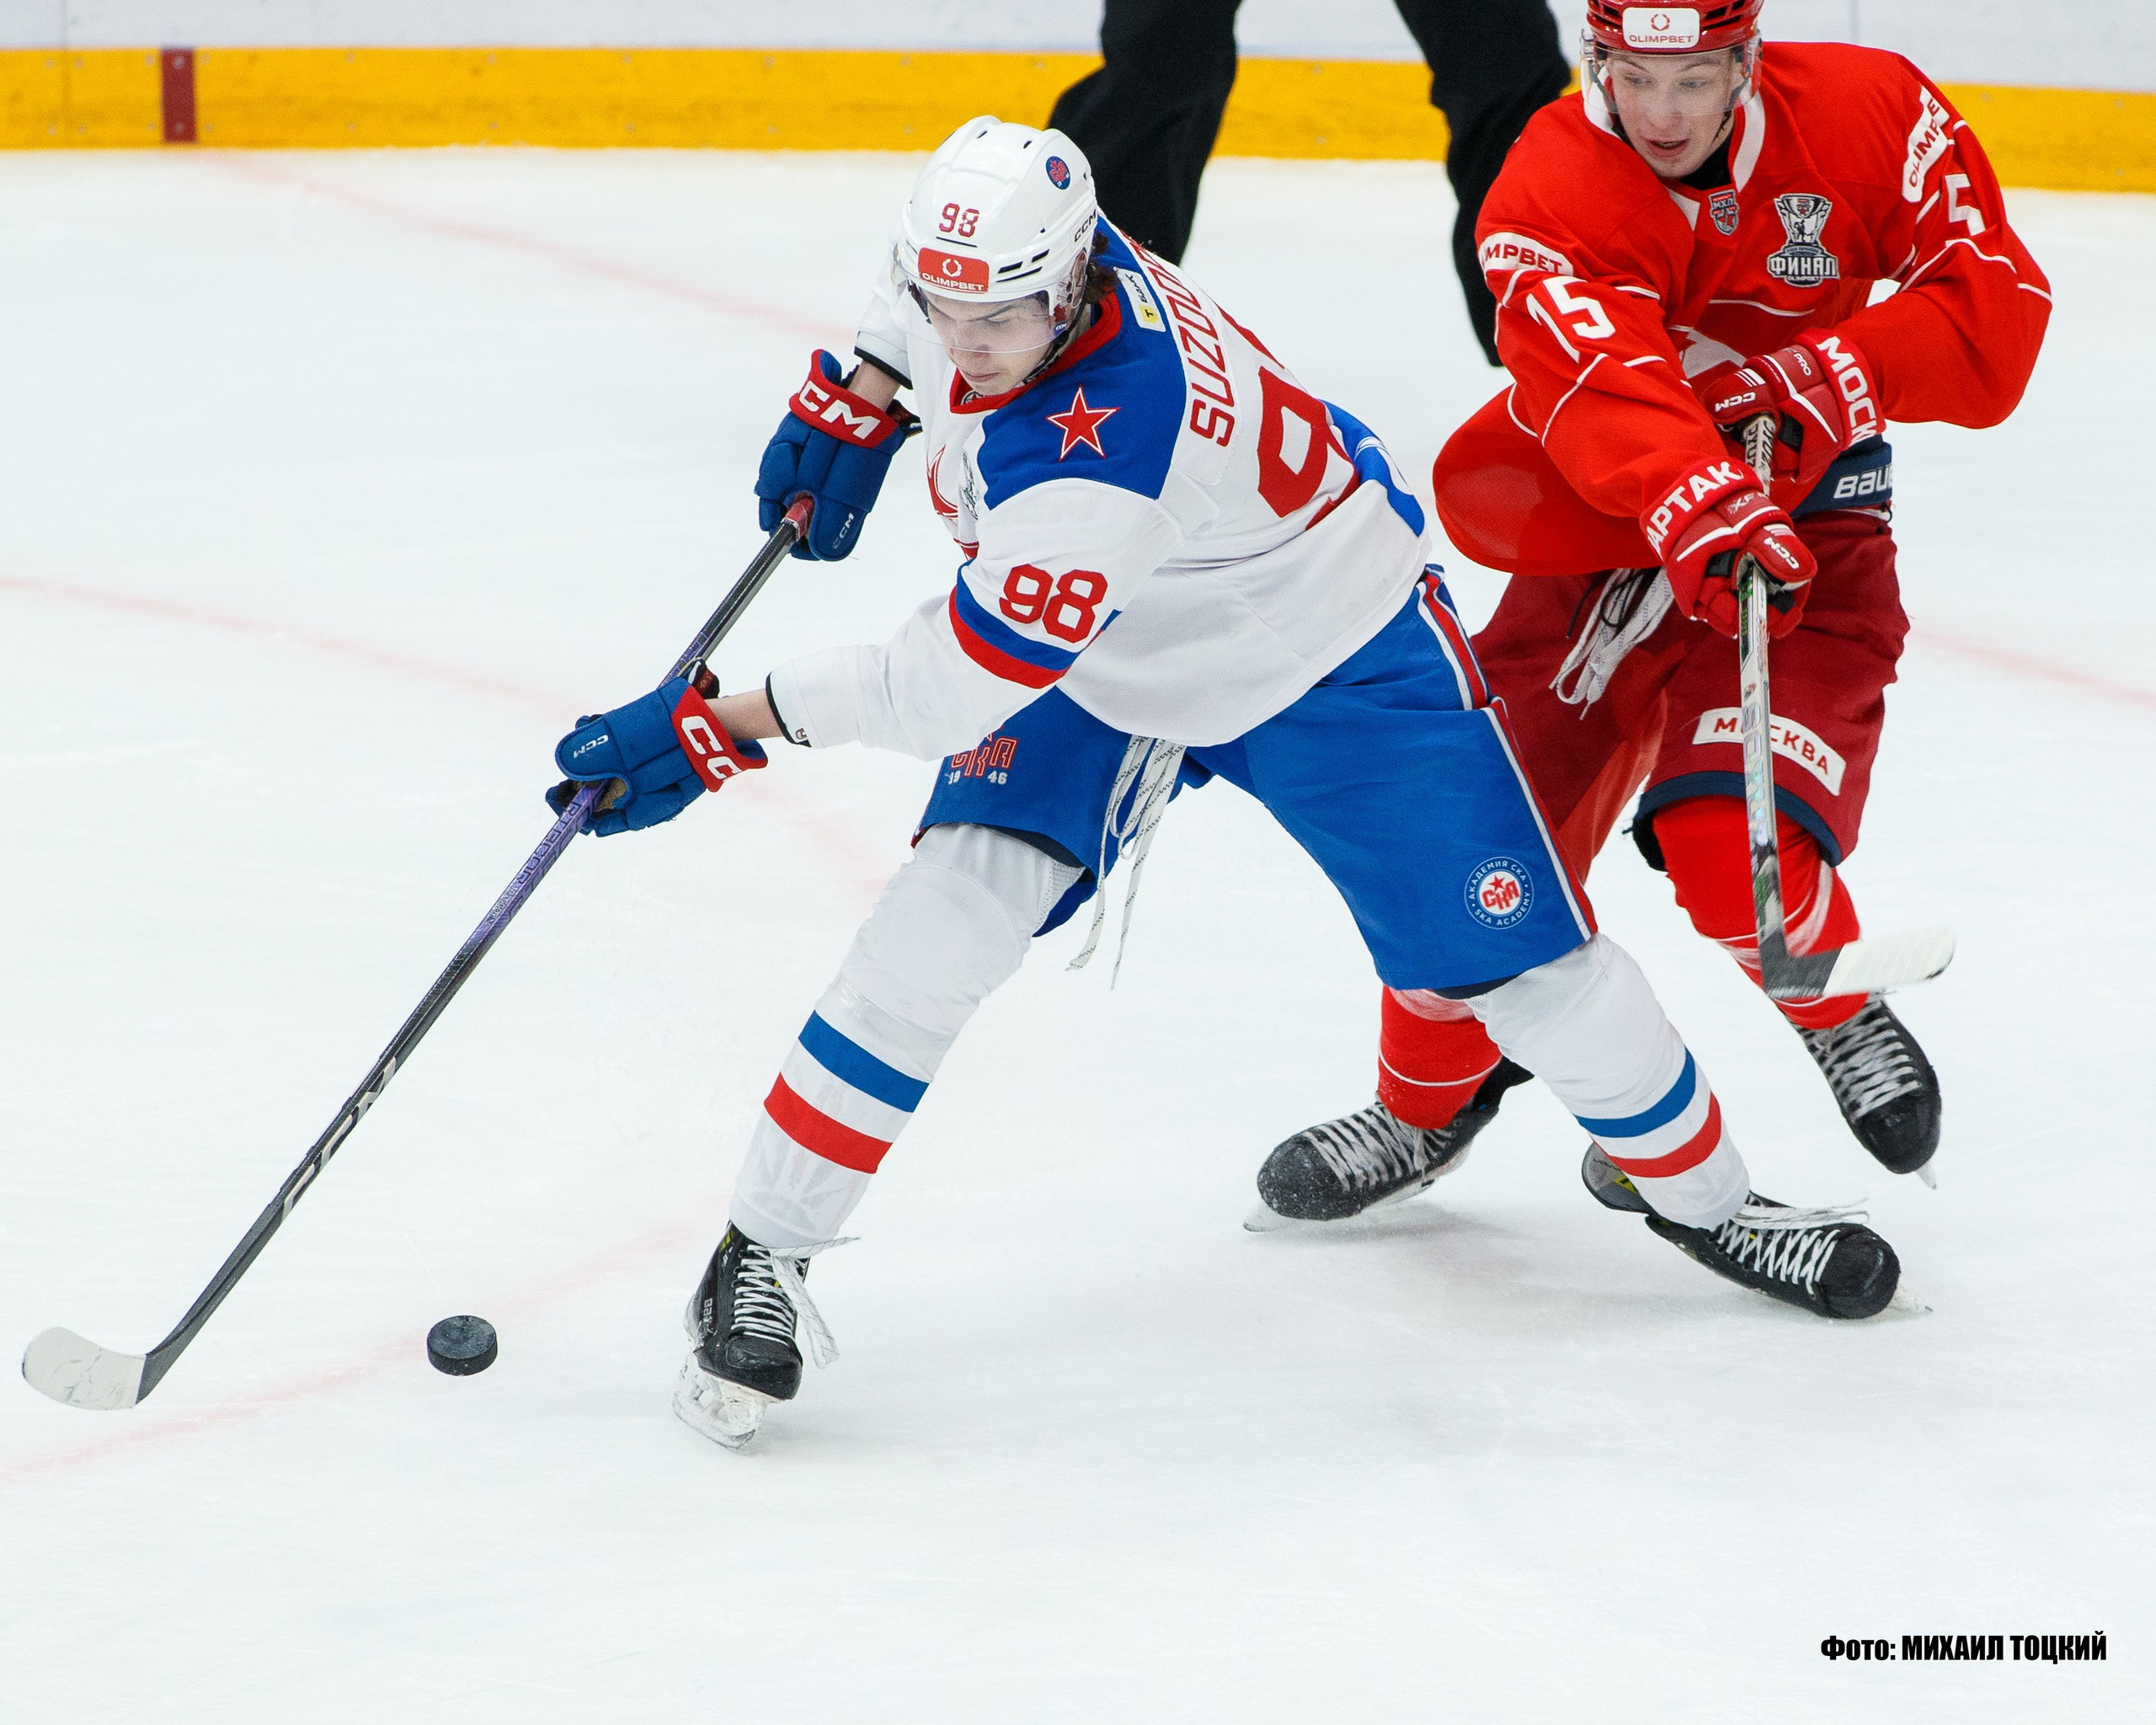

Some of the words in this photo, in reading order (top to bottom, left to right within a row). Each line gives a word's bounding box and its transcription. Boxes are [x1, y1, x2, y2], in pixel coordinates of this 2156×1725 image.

[1629, 35, 1694, 44] OLIMPBET
[1909, 98, 1940, 188] OLIMPE
[939, 202, 980, 238] 98
[1074, 209, 1097, 243] CCM
[1485, 243, 1562, 275] MPBET
[1770, 256, 1836, 275] ФИНАЛ
[921, 272, 985, 291] OLIMPBET
[1526, 275, 1616, 364] 15
[1793, 353, 1812, 377] PRO
[1715, 392, 1757, 414] CCM
[1816, 335, 1878, 446] МОСК
[798, 380, 882, 441] CM
[1833, 464, 1893, 499] BAU
[1646, 461, 1745, 561] АРТАК
[832, 512, 855, 549] CCM
[1764, 537, 1800, 570] CCM
[998, 563, 1108, 644] 98
[573, 734, 609, 759] CCM
[681, 715, 743, 780] CC
[1713, 717, 1828, 776] МСКВА
[948, 770, 961, 785] 19
[988, 770, 1008, 785] 46
[1468, 860, 1508, 900] АКАДЕМИЯ
[1510, 864, 1527, 882] СКА
[1482, 880, 1520, 911] СКА
[1474, 909, 1492, 924] SKA
[1497, 892, 1530, 926] ACADEMY
